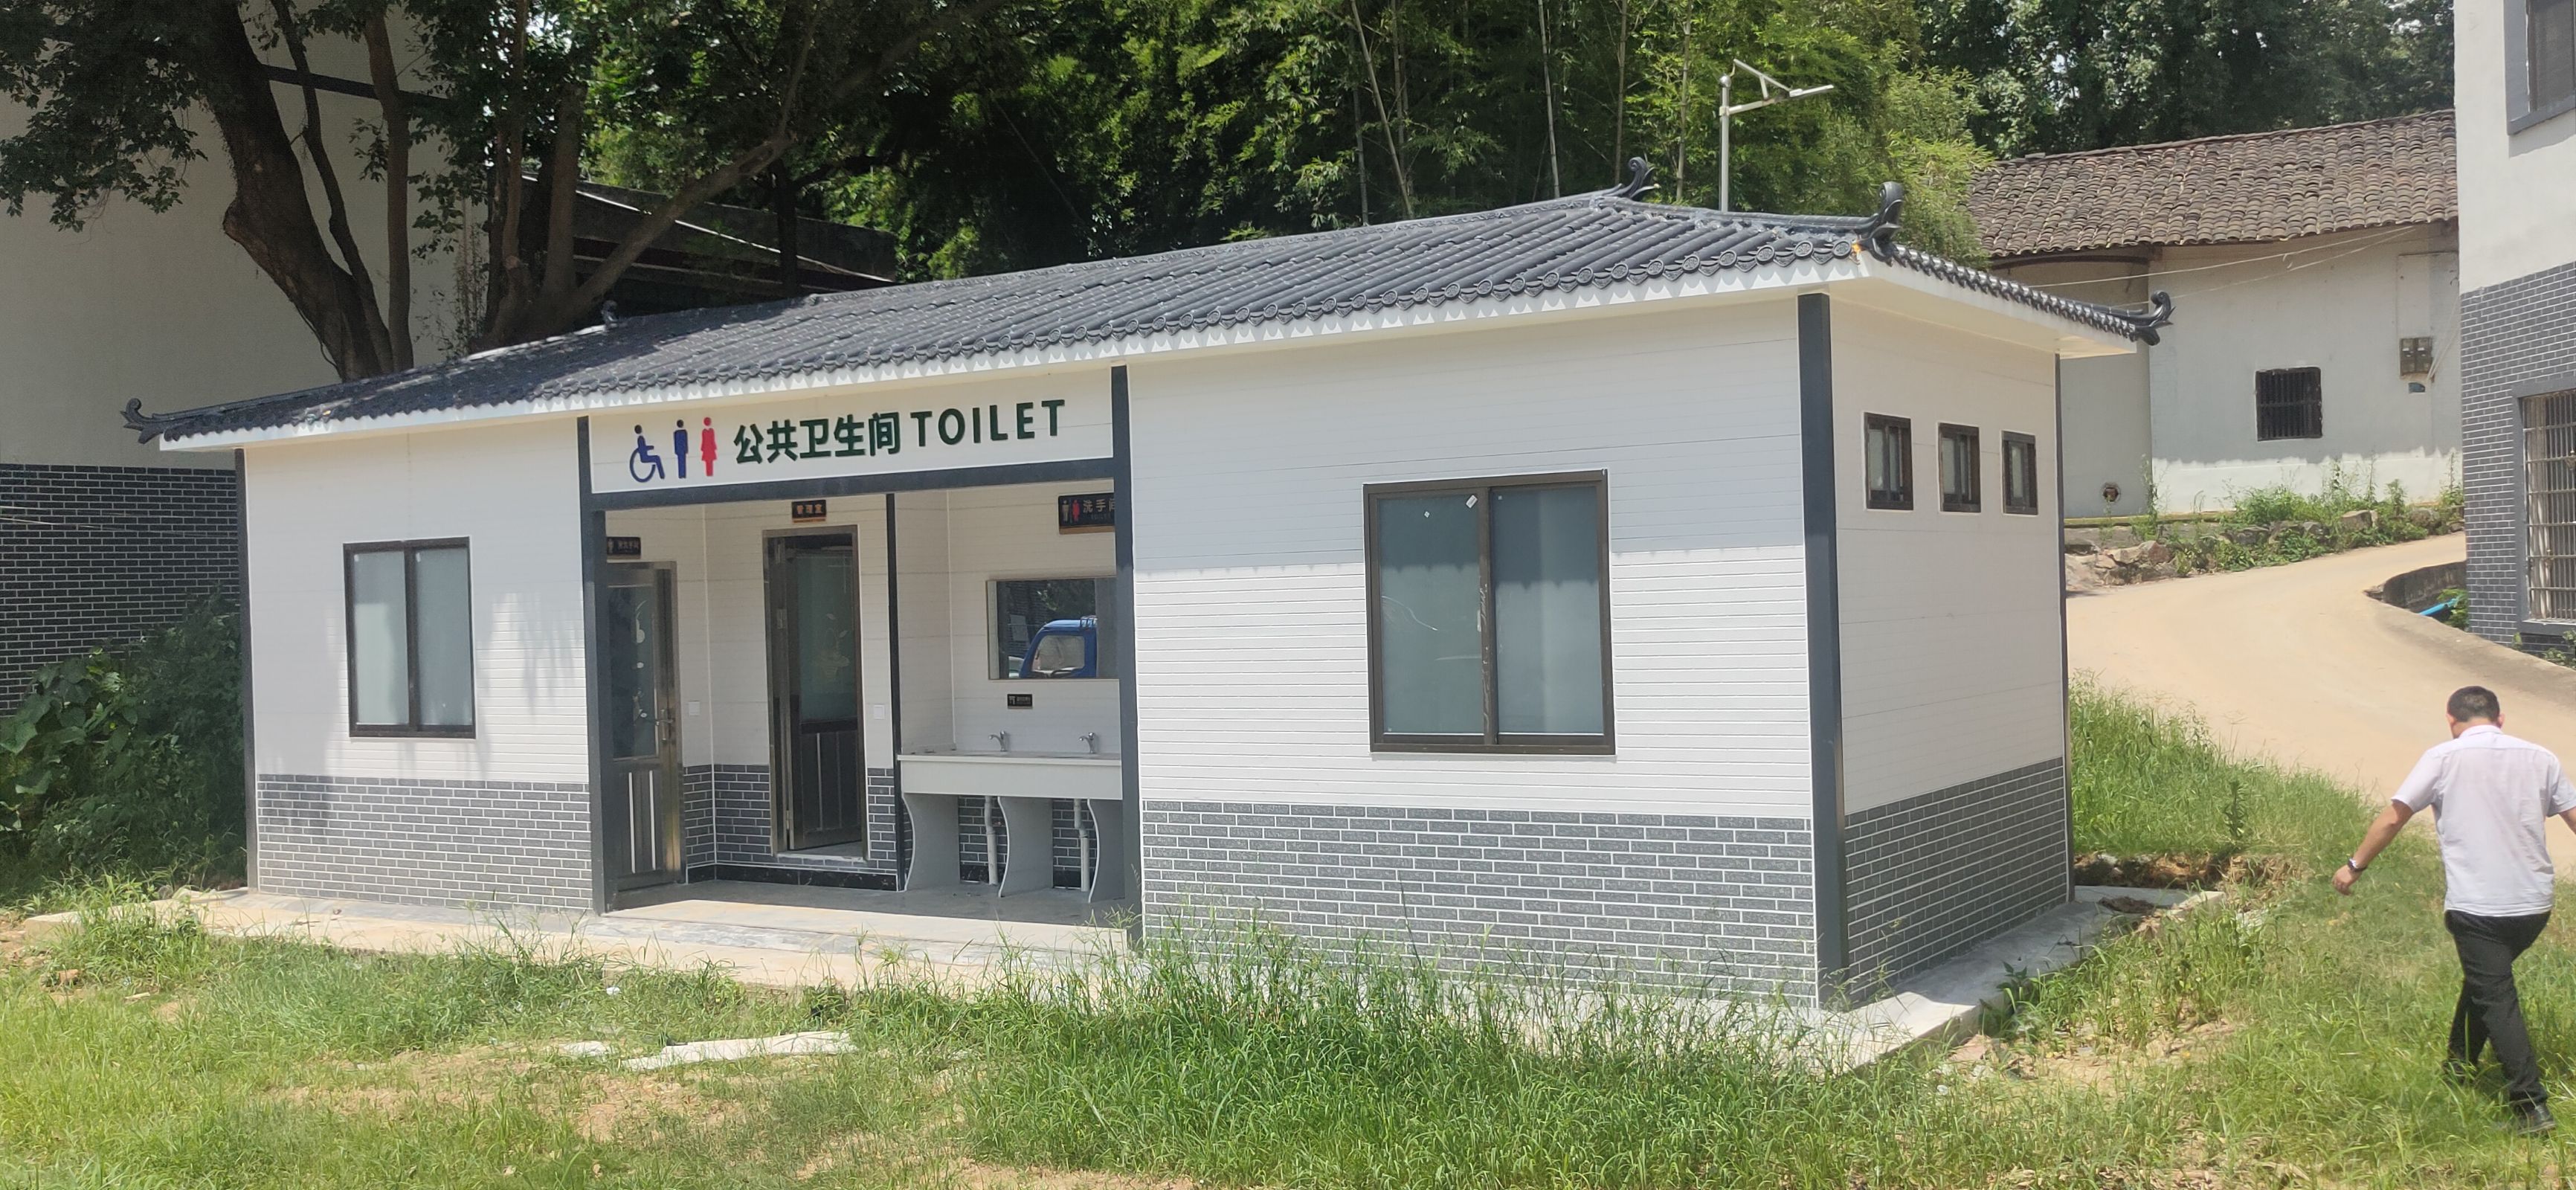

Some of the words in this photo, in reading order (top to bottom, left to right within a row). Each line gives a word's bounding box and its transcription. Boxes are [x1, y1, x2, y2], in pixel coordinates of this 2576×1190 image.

[733, 411, 901, 464] 公共卫生间
[909, 399, 1066, 447] TOILET
